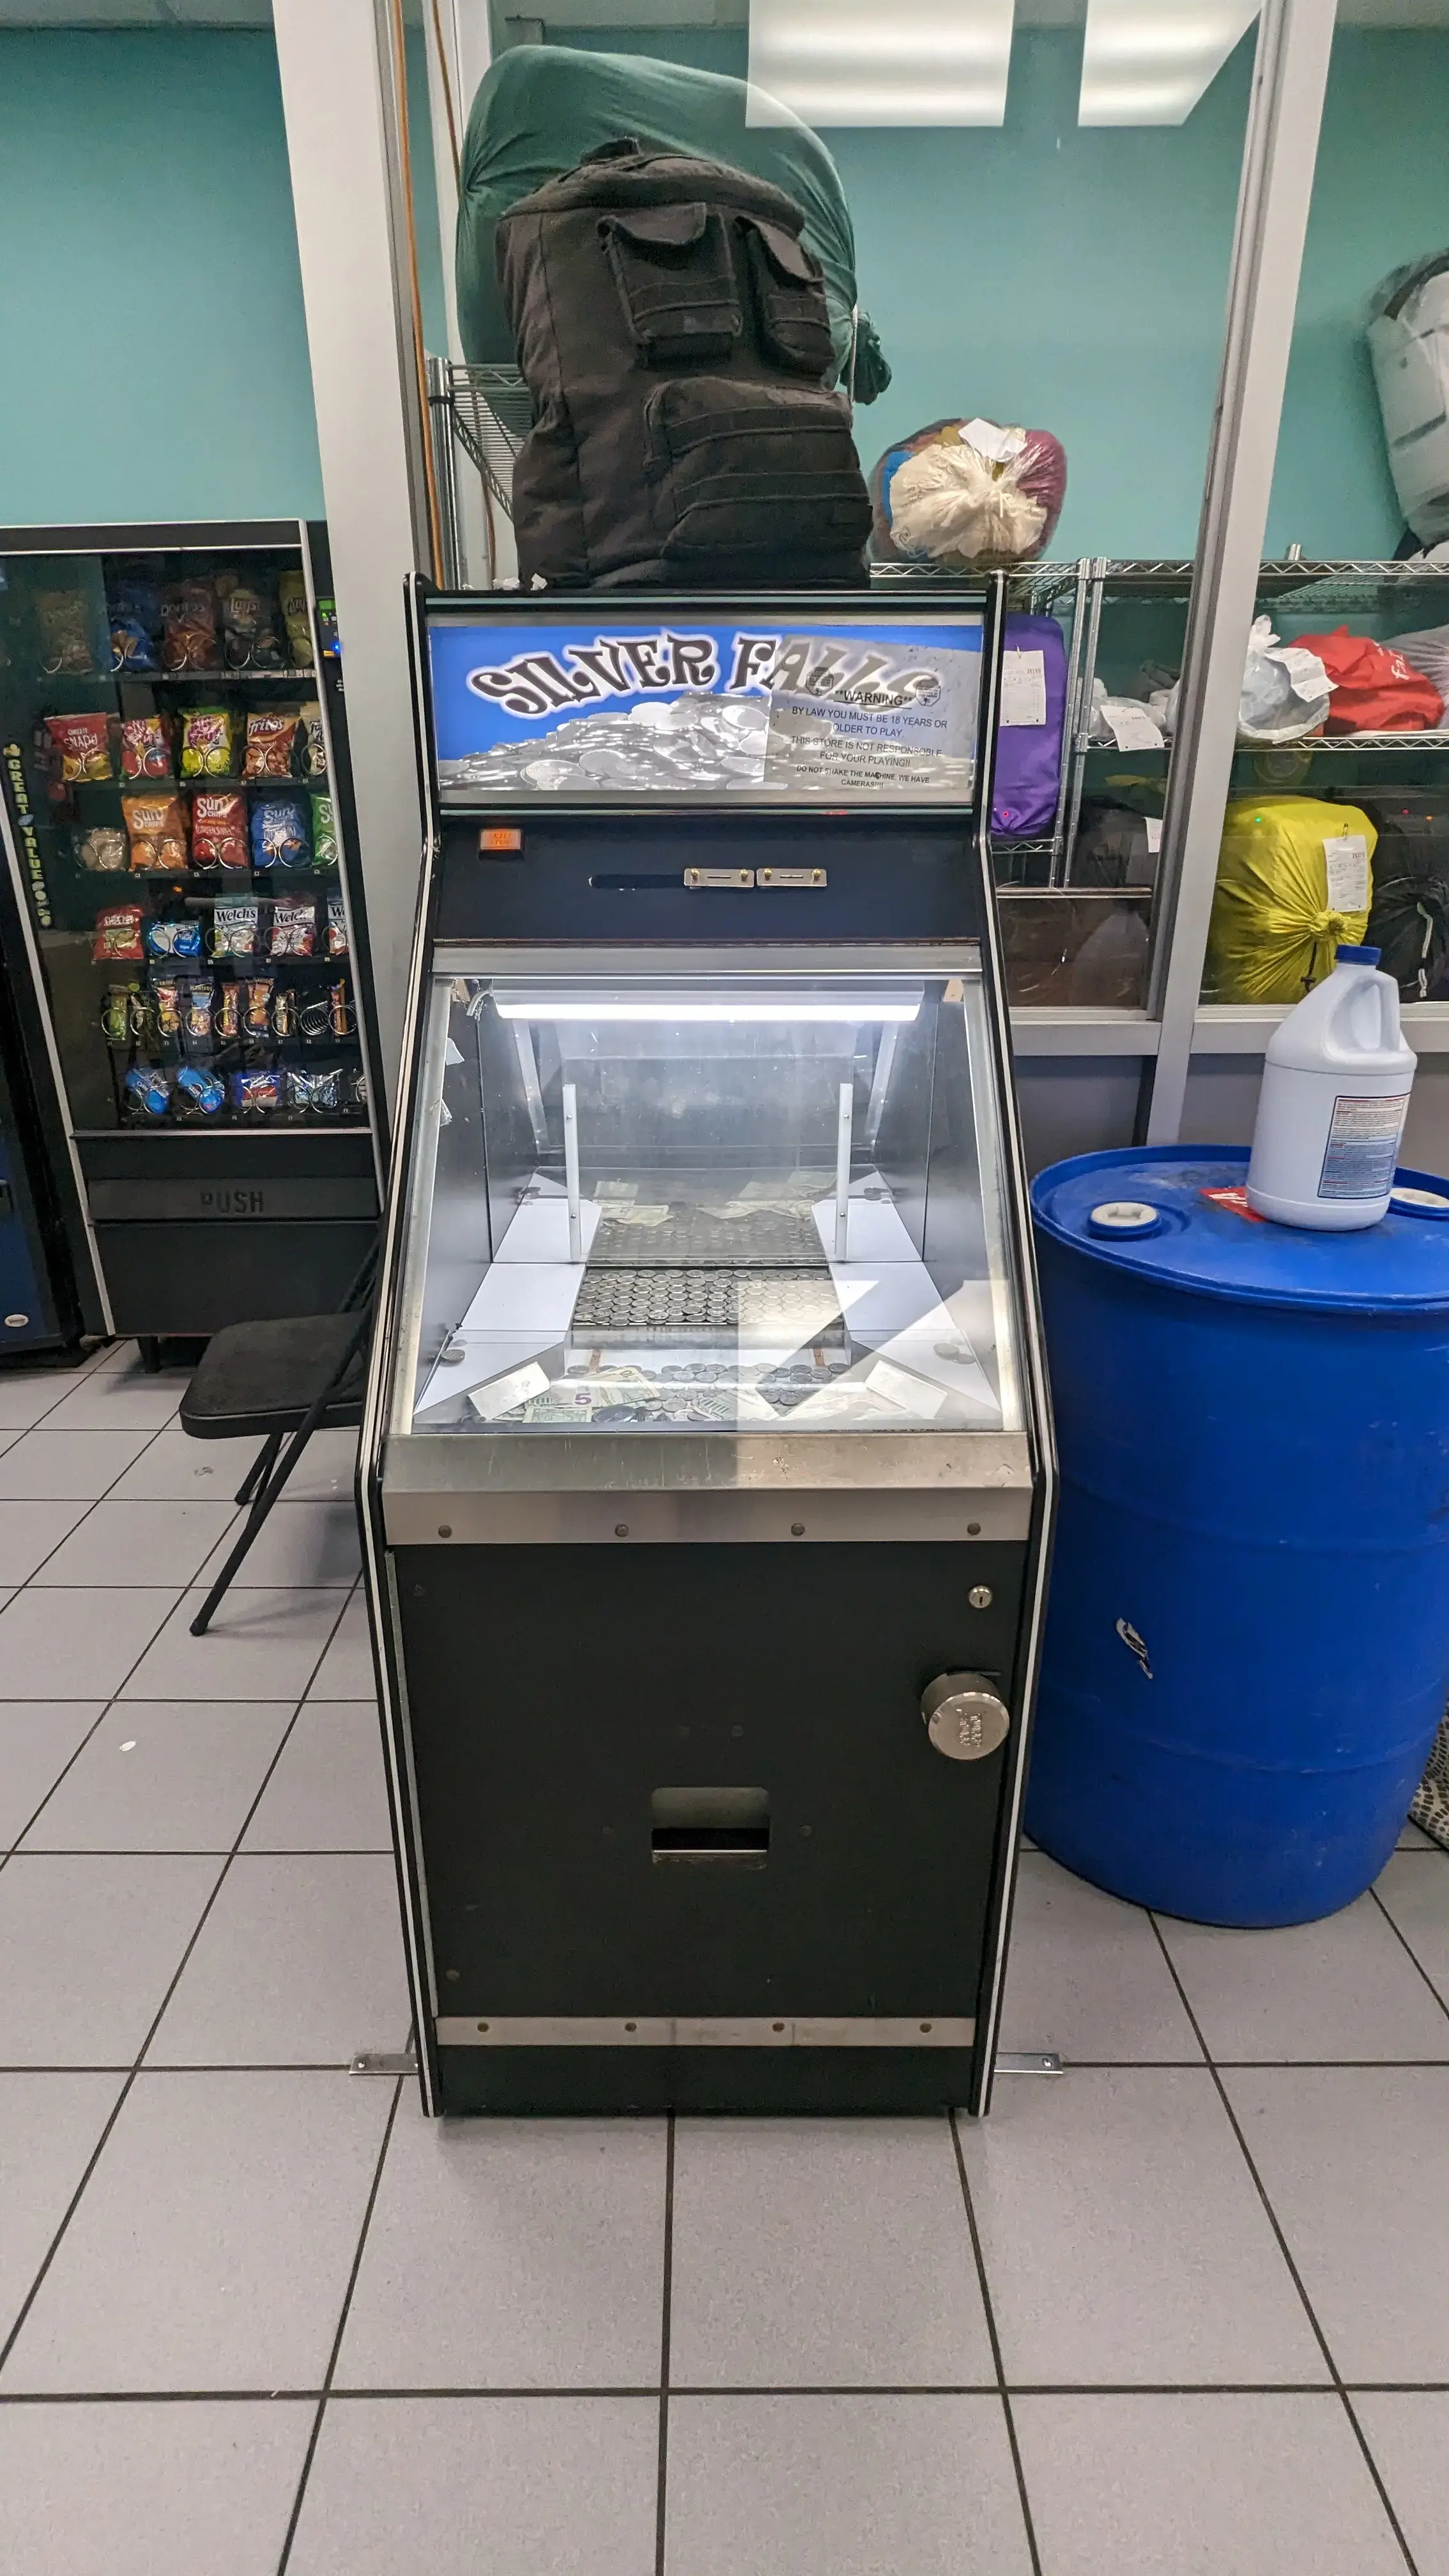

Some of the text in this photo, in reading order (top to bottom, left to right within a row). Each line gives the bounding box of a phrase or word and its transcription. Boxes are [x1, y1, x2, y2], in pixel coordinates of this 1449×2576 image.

[470, 634, 716, 714] SILVER
[792, 705, 948, 729] BY LAW YOU MUST BE 18 YEARS OR
[832, 723, 862, 733] OLDER
[865, 726, 878, 735] TO
[792, 735, 811, 745] THIS
[813, 738, 843, 749] STORE
[845, 741, 854, 749] IS
[856, 742, 875, 751] NOT
[819, 751, 839, 761] FOR
[841, 753, 866, 763] YOUR
[824, 767, 849, 777] SHAKE
[911, 776, 930, 784] HAVE
[7, 758, 29, 815] GREAT
[20, 827, 43, 880] VALUE
[217, 908, 256, 923] Welch's
[200, 1190, 264, 1214] PUSH
[575, 1392, 592, 1406] 5
